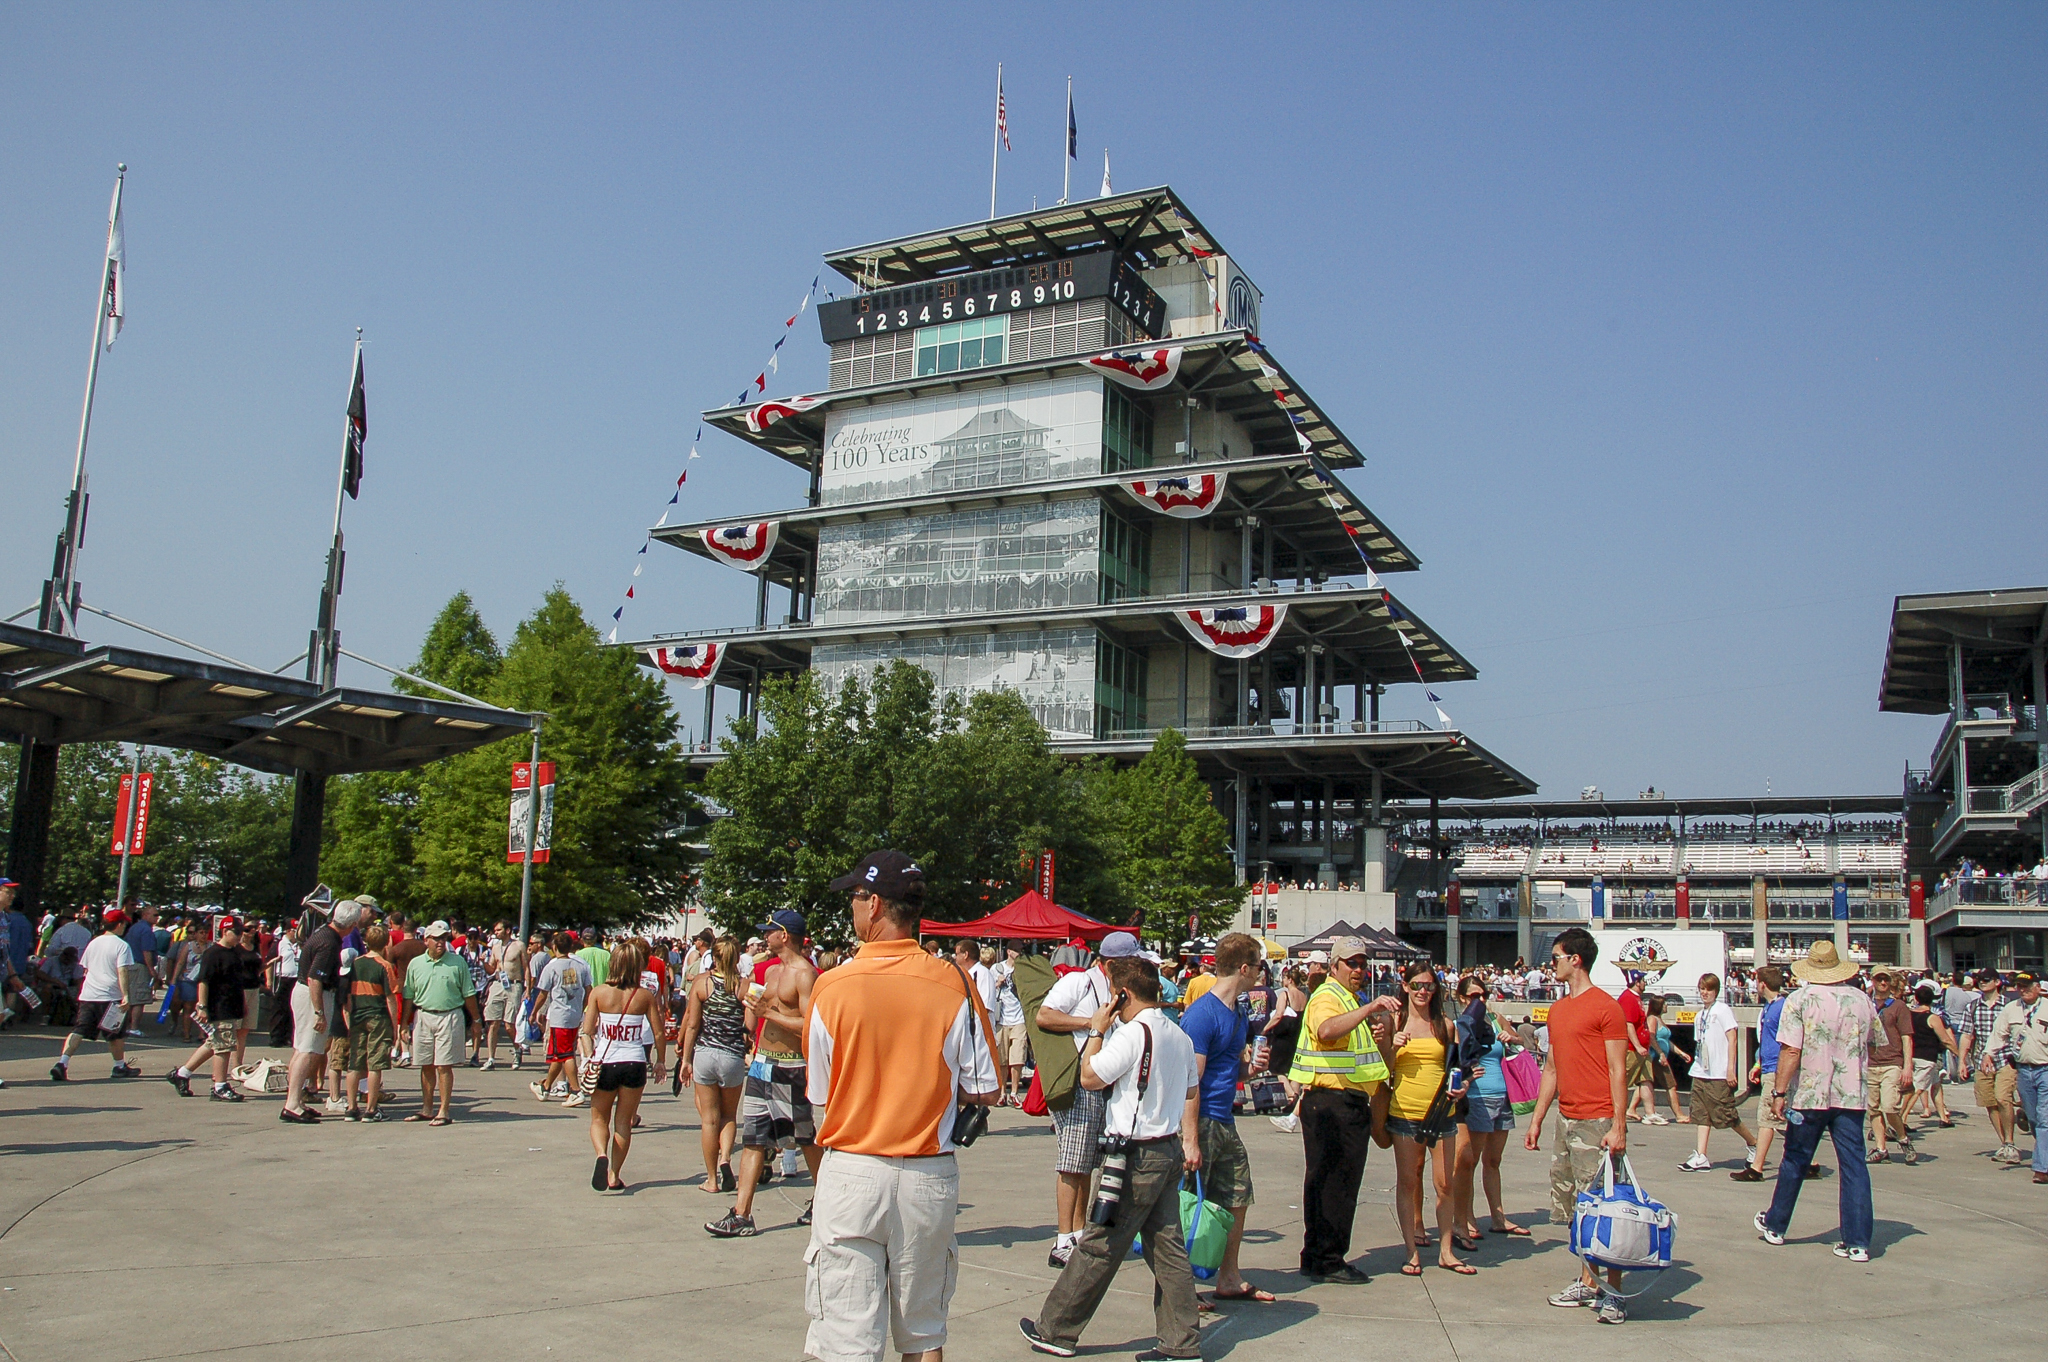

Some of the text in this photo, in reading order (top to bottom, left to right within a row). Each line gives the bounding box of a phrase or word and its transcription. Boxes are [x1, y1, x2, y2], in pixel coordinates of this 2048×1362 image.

[856, 280, 1075, 334] 1 2 3 4 5 6 7 8 9 10
[1113, 281, 1150, 326] 1 2 3 4
[831, 425, 912, 449] Celebrating
[832, 441, 928, 471] 100 Years
[864, 865, 879, 882] 2
[1143, 1052, 1151, 1068] EOS
